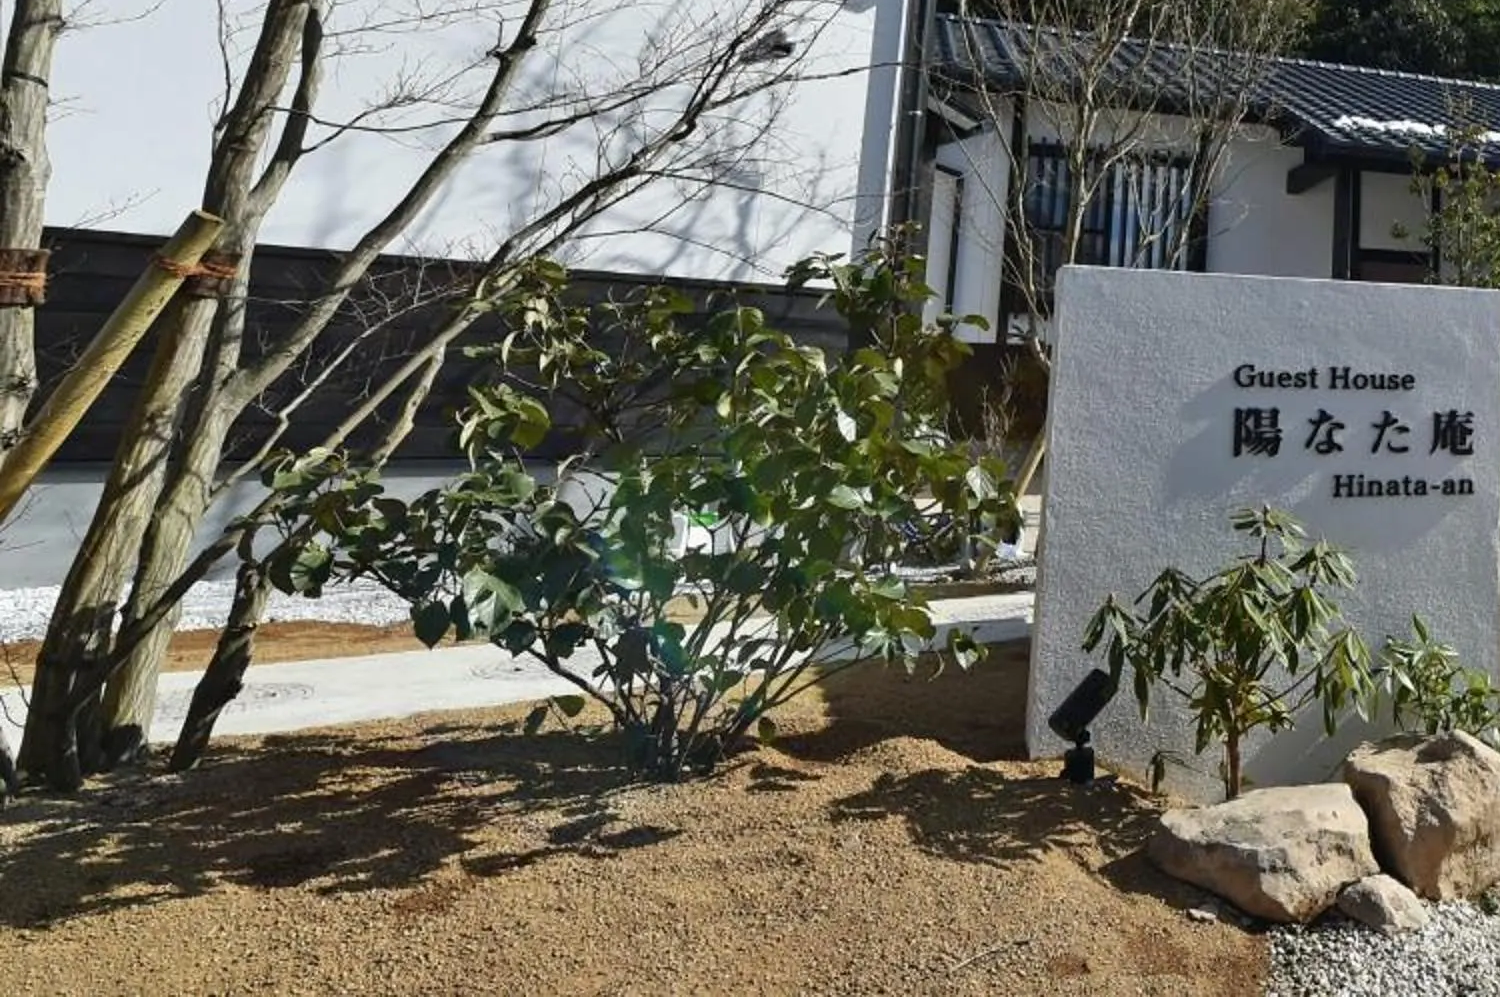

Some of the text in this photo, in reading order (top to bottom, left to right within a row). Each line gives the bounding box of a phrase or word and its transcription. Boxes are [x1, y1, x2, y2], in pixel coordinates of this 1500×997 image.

[1233, 364, 1415, 390] Guest House
[1233, 407, 1475, 457] 陽なた庵
[1333, 474, 1474, 498] Hinata-an
